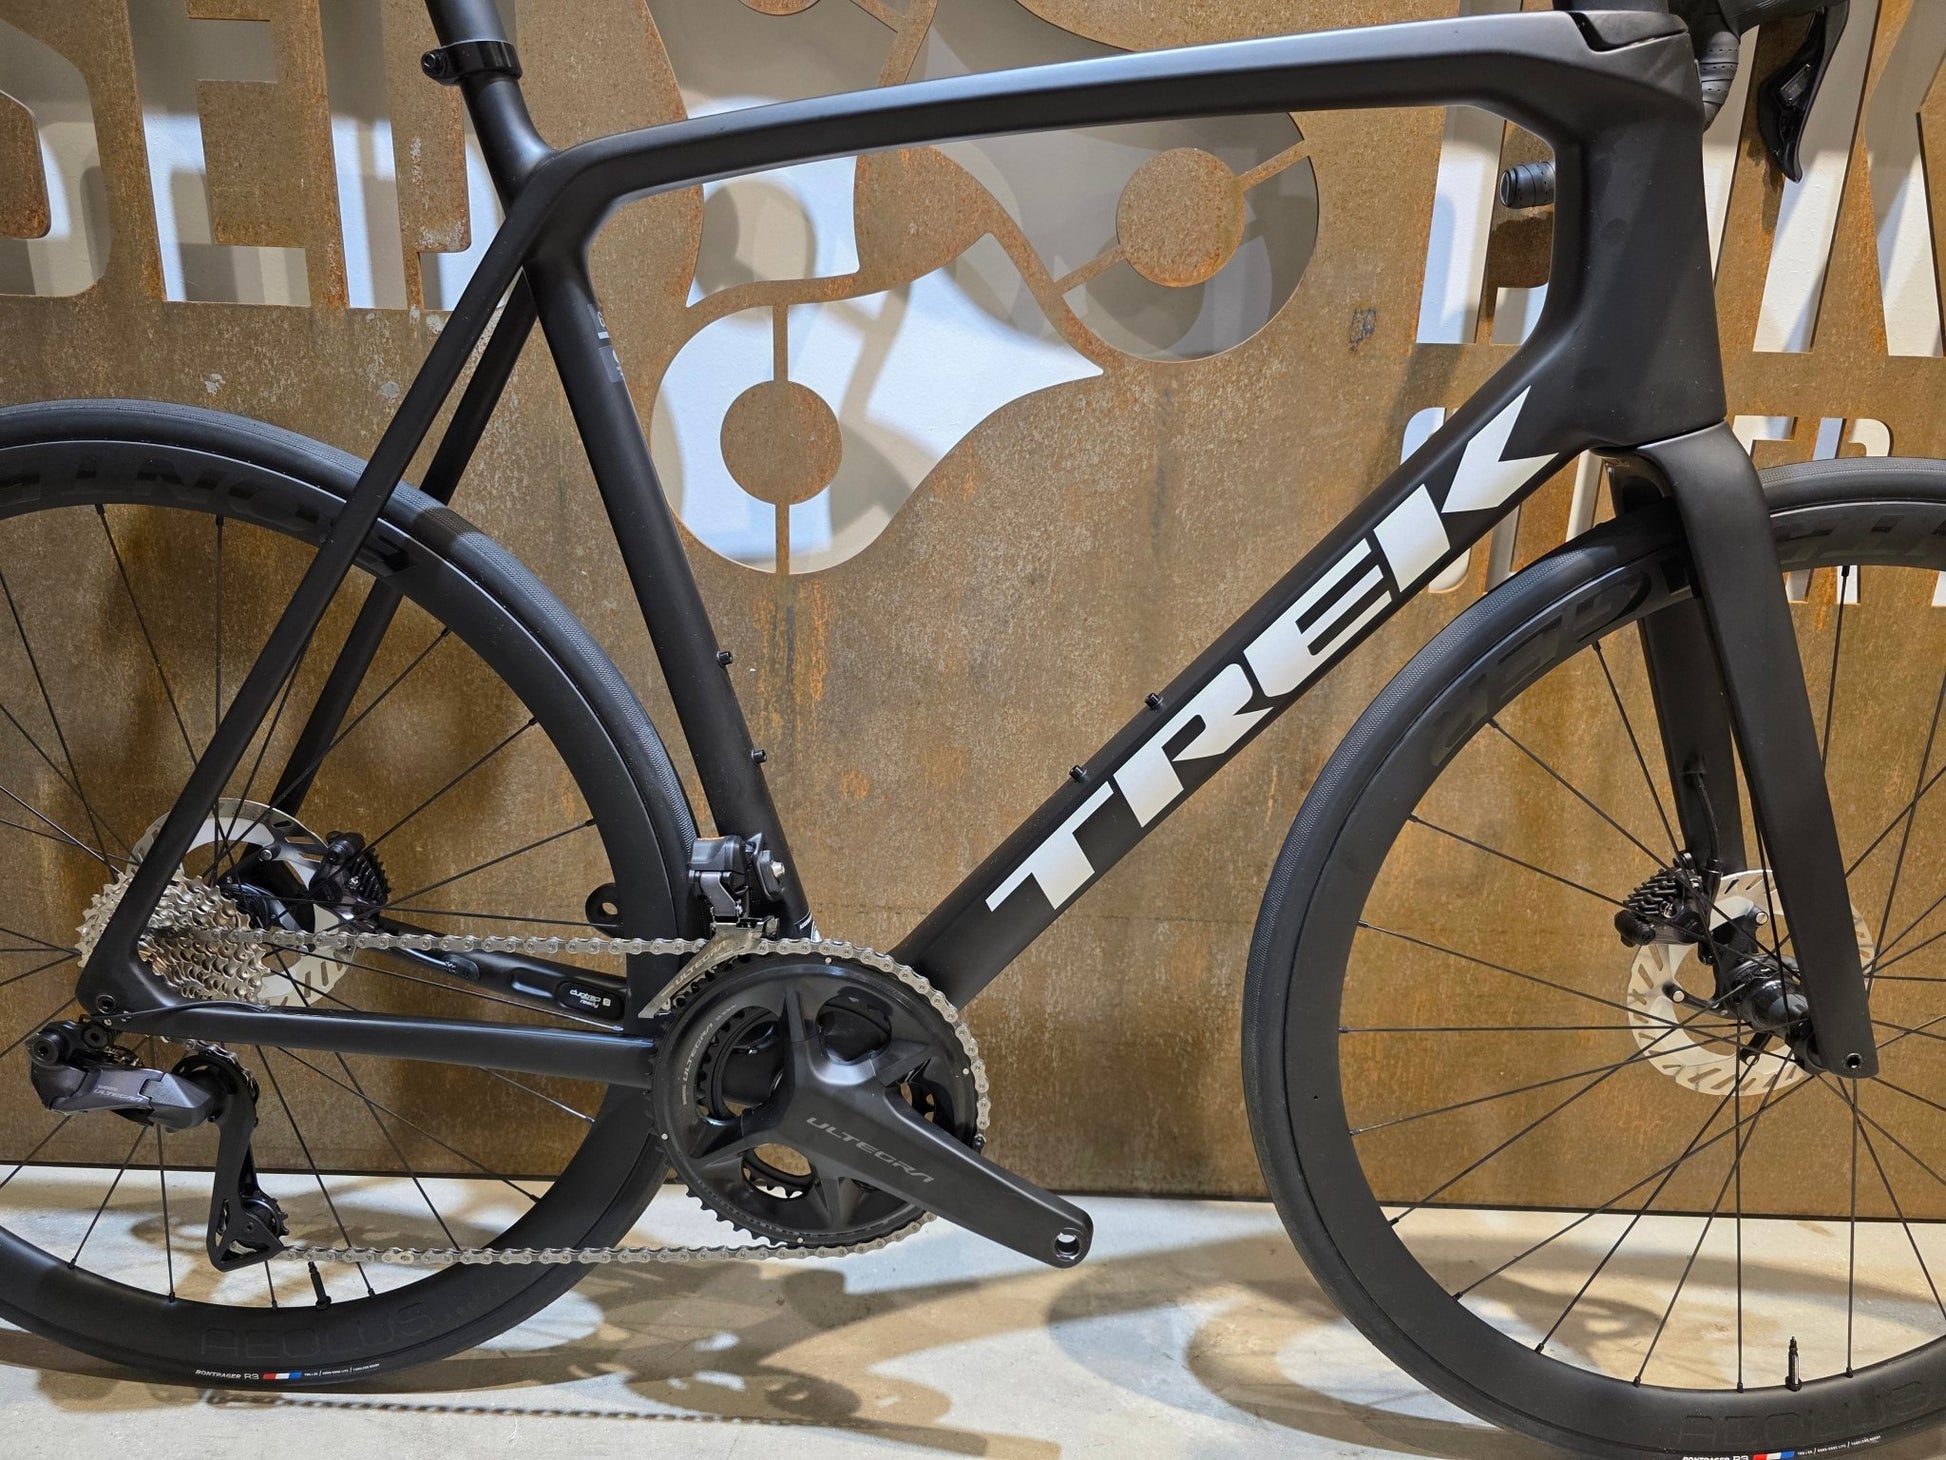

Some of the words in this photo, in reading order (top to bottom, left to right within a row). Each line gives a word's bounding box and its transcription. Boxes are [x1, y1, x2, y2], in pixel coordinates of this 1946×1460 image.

[985, 386, 1559, 914] TREK
[675, 941, 726, 985] ULTEGRA
[683, 1022, 713, 1082] ULTEGRA
[806, 1117, 935, 1184] ULTEGRA
[194, 1368, 242, 1379] BONTRAGER
[243, 1372, 260, 1380] R3
